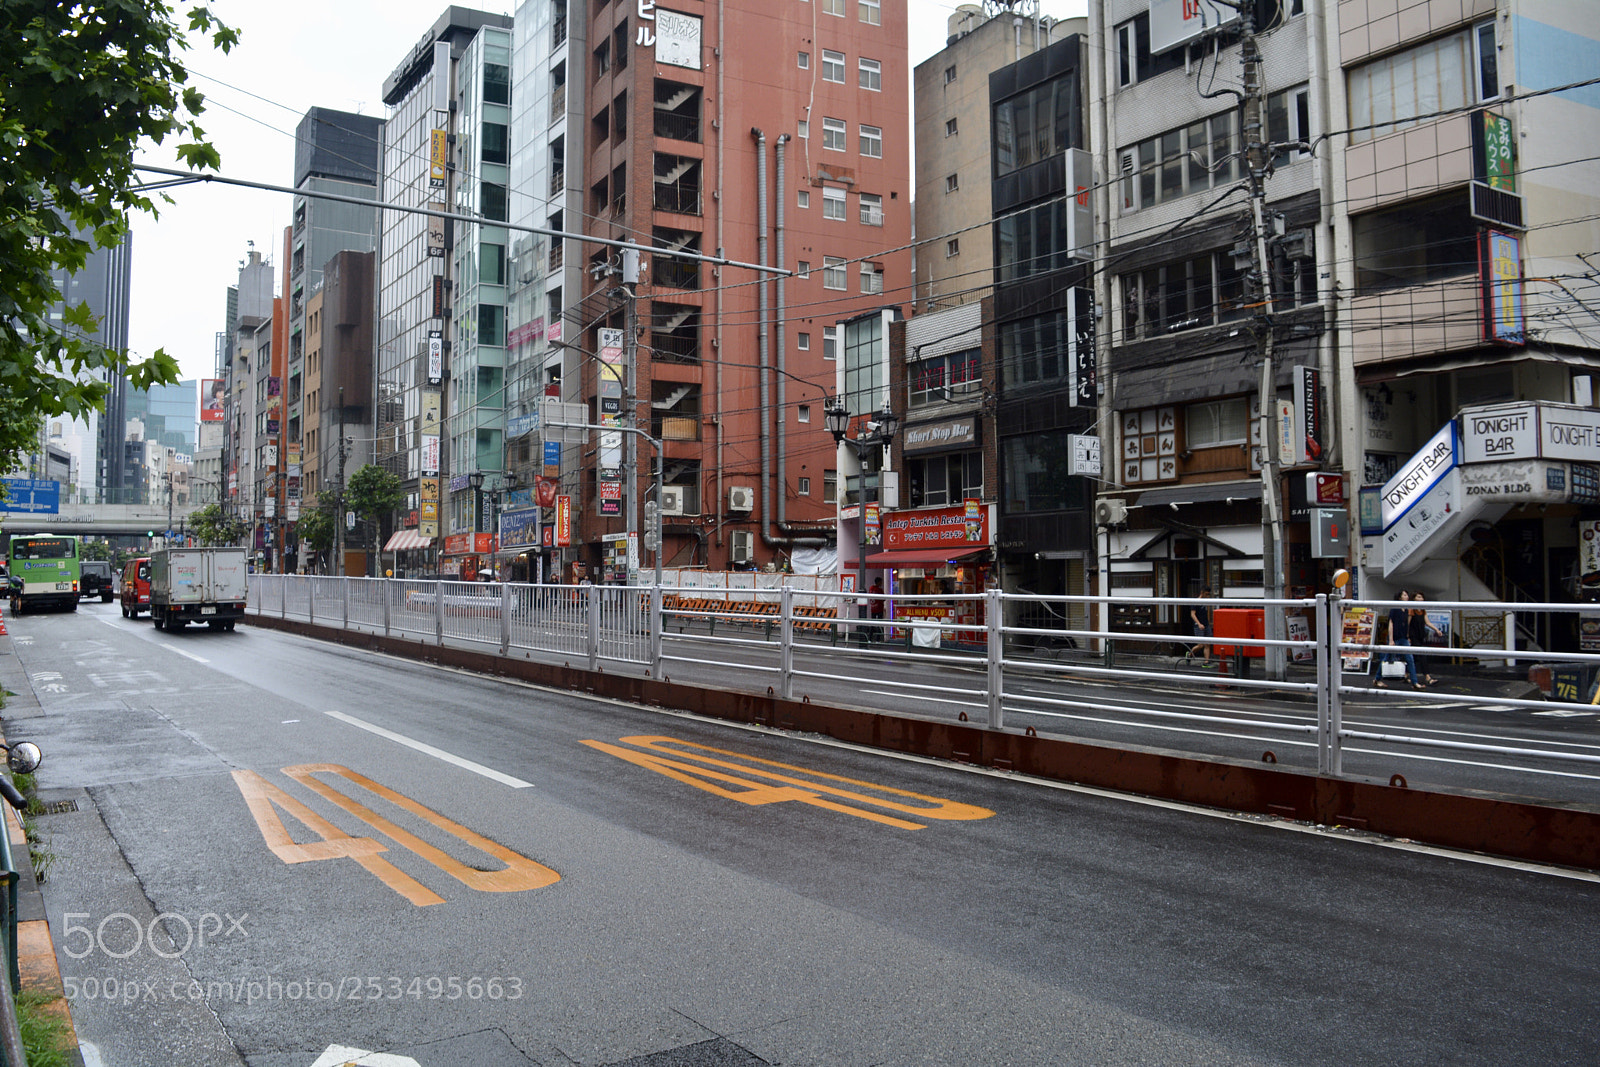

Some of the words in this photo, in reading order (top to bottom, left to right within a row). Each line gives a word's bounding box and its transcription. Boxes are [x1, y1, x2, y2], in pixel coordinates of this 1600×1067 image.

[636, 0, 656, 47] ビル
[658, 13, 699, 39] ミリオン
[1498, 118, 1511, 159] もみの
[1488, 133, 1499, 172] ハウス
[431, 247, 442, 256] 6F
[1076, 331, 1091, 399] いちえ
[1306, 371, 1314, 438] KUISHINBO
[907, 430, 931, 445] Short
[931, 427, 951, 441] Stop
[952, 423, 970, 437] Bar
[1471, 412, 1528, 435] TONIGHT
[1546, 421, 1593, 446] TONIGHT
[1485, 437, 1515, 456] BAR
[1381, 462, 1429, 508] TONIGHT
[1423, 442, 1452, 471] BAR
[1466, 485, 1501, 495] ZONAN
[1504, 483, 1531, 494] BLDG
[886, 519, 909, 530] Antep
[910, 516, 939, 528] Turkish
[940, 513, 985, 526] Restaut
[940, 531, 964, 540] レストラン
[1388, 532, 1398, 543] B1
[1389, 542, 1411, 565] WHITE
[1409, 523, 1431, 548] HOUSE
[1431, 511, 1445, 528] BAR
[578, 734, 996, 832] 40
[231, 764, 561, 908] 40
